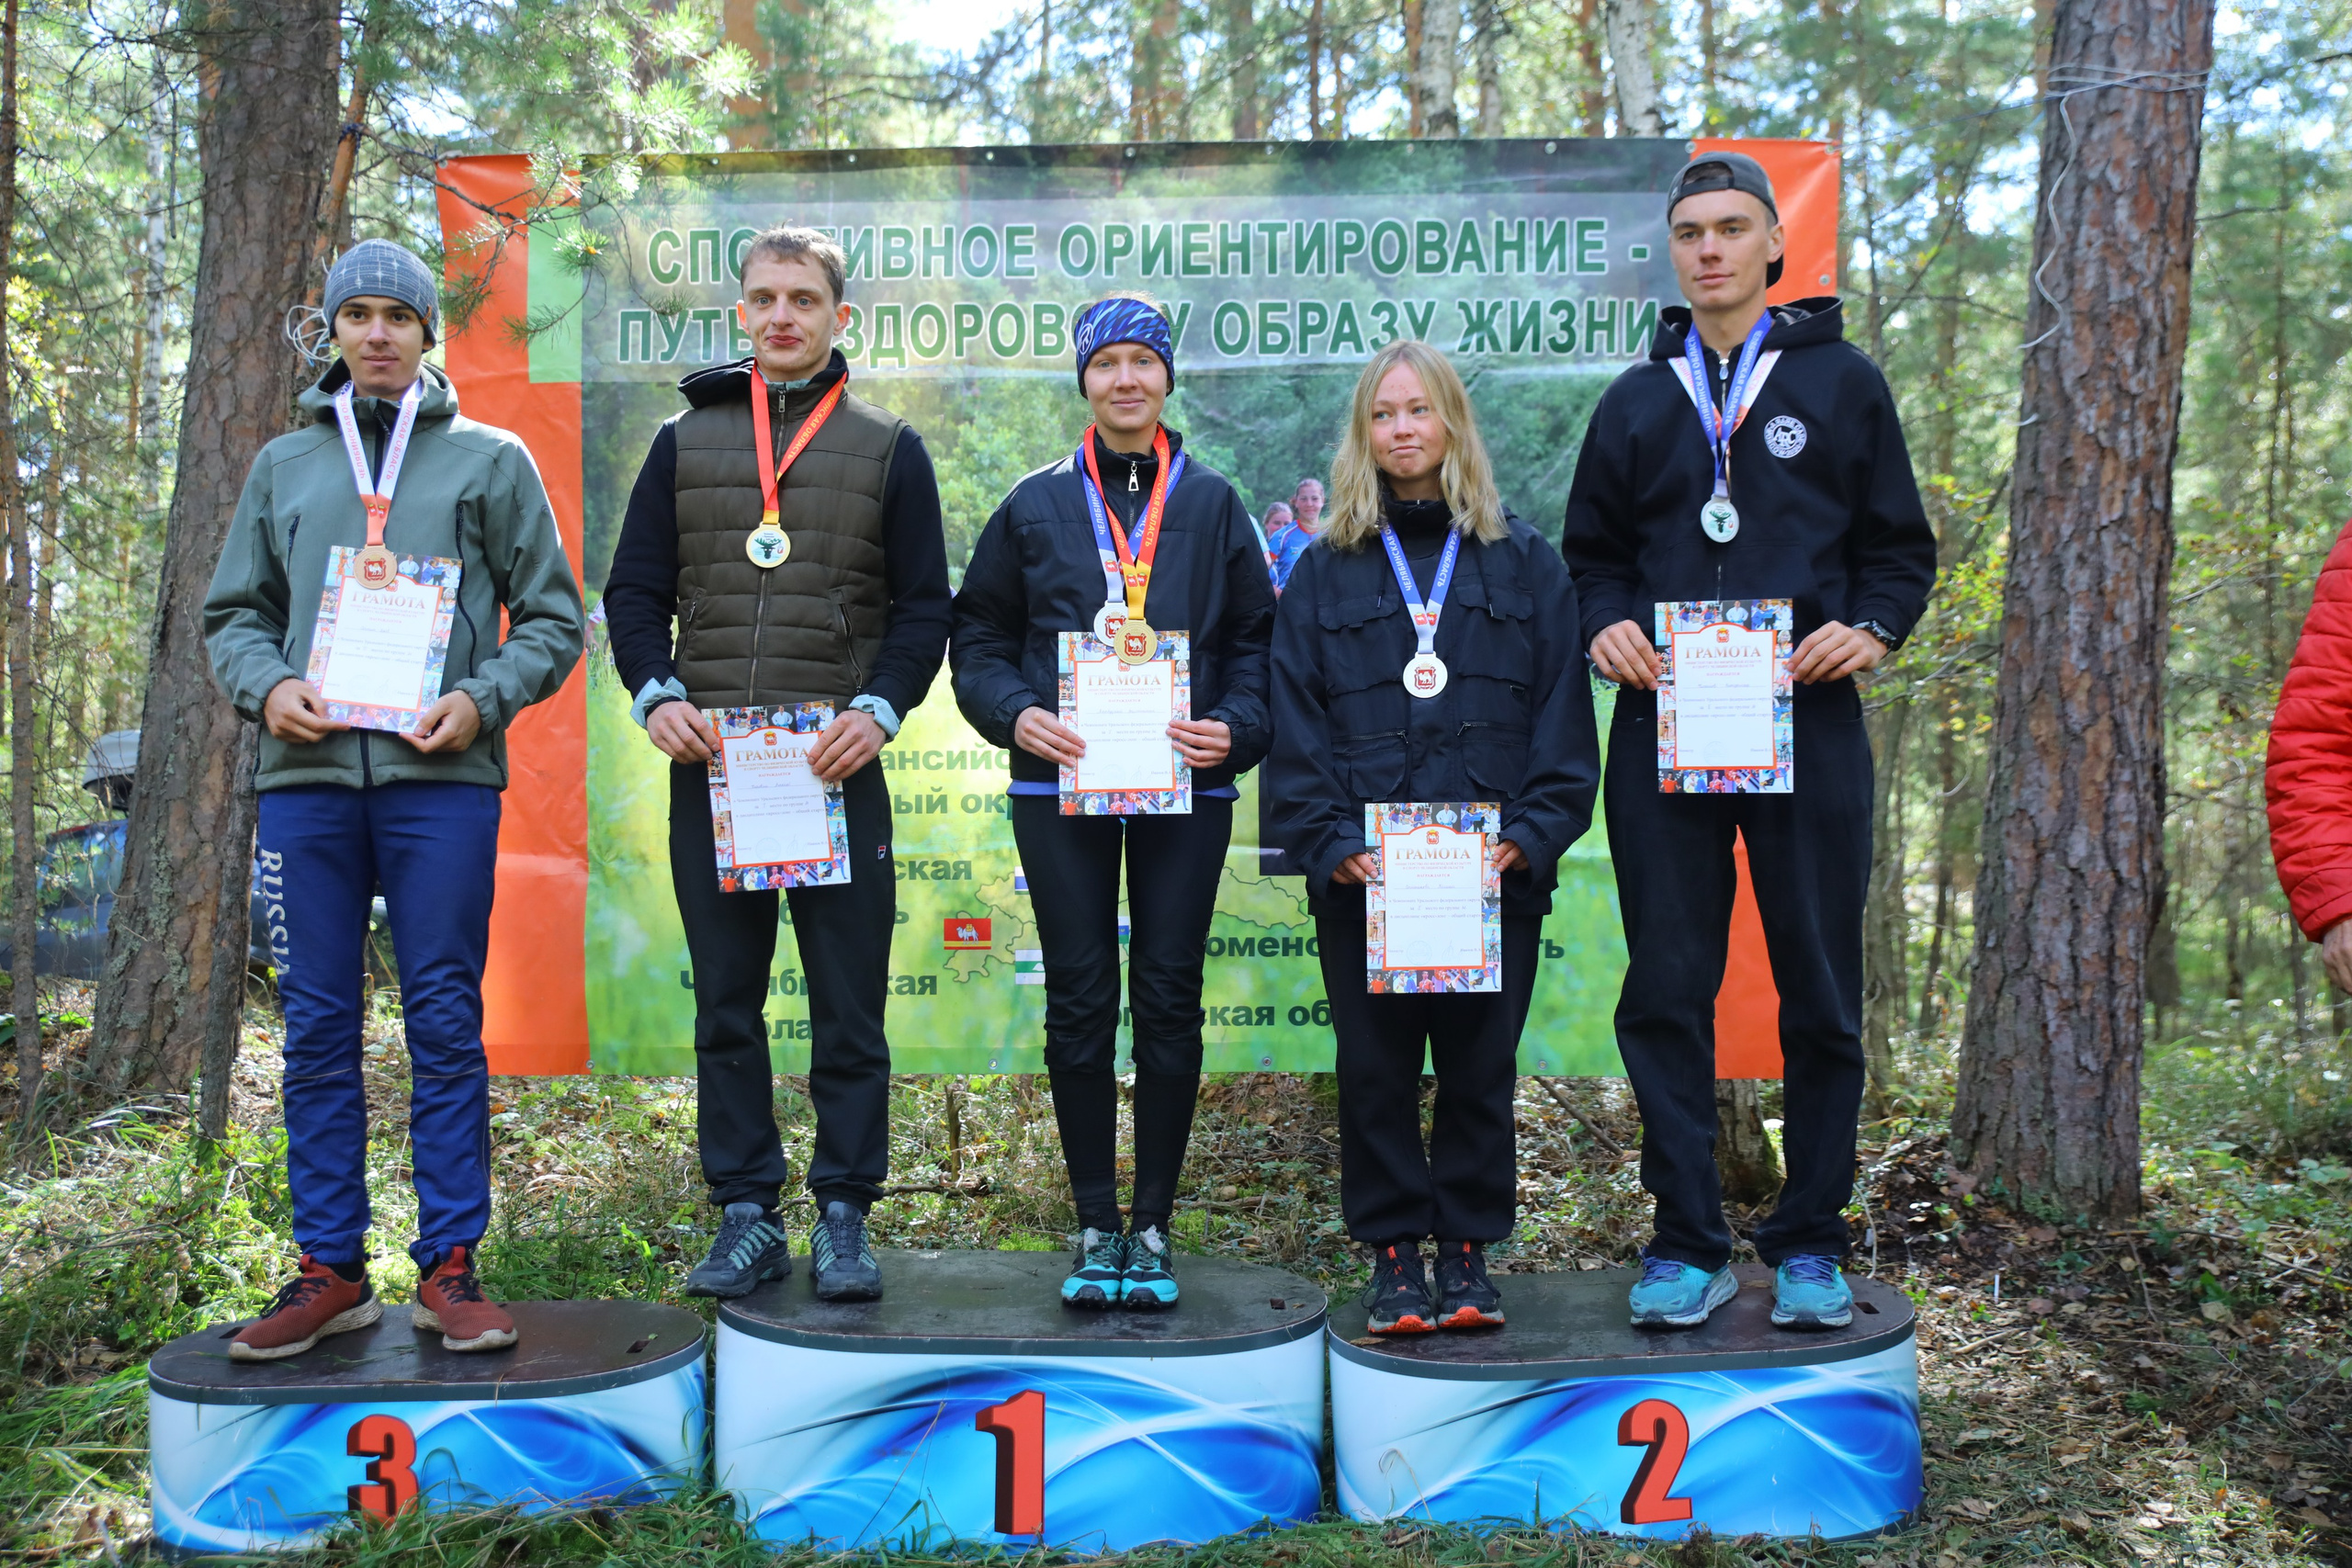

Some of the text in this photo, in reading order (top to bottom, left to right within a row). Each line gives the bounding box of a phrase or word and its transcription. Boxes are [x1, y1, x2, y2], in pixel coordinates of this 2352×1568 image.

[649, 222, 1036, 286] СПОИВНОЕ
[1059, 218, 1608, 278] ОРИЕНТИРОВАНИЕ
[618, 297, 1659, 370] ПУТЬ ЗДОРОВУ ОБРАЗУ ЖИЗНИ
[1723, 384, 1743, 426] ОБЛАСТЬ
[384, 439, 404, 480] ОБЛАСТЬ
[786, 425, 814, 460] ОБЛАСТЬ
[1144, 446, 1166, 547] ЧЕЛЯБИНСКАЯ ОБЛАСТЬ
[1385, 534, 1413, 592] ЧЕЛЯБИНСКАЯ
[1435, 549, 1453, 588] ОБЛАСТЬ
[352, 590, 426, 610] ГРАМОТА
[1684, 646, 1762, 660] ГРАМОТА
[1087, 674, 1161, 686] ГРАМОТА
[735, 747, 808, 762] ГРАМОТА
[1395, 847, 1471, 861] ГРАМОТА
[260, 848, 291, 976] RUSSIA
[346, 1413, 421, 1533] 3
[975, 1388, 1046, 1536] 1
[1617, 1397, 1693, 1525] 2
